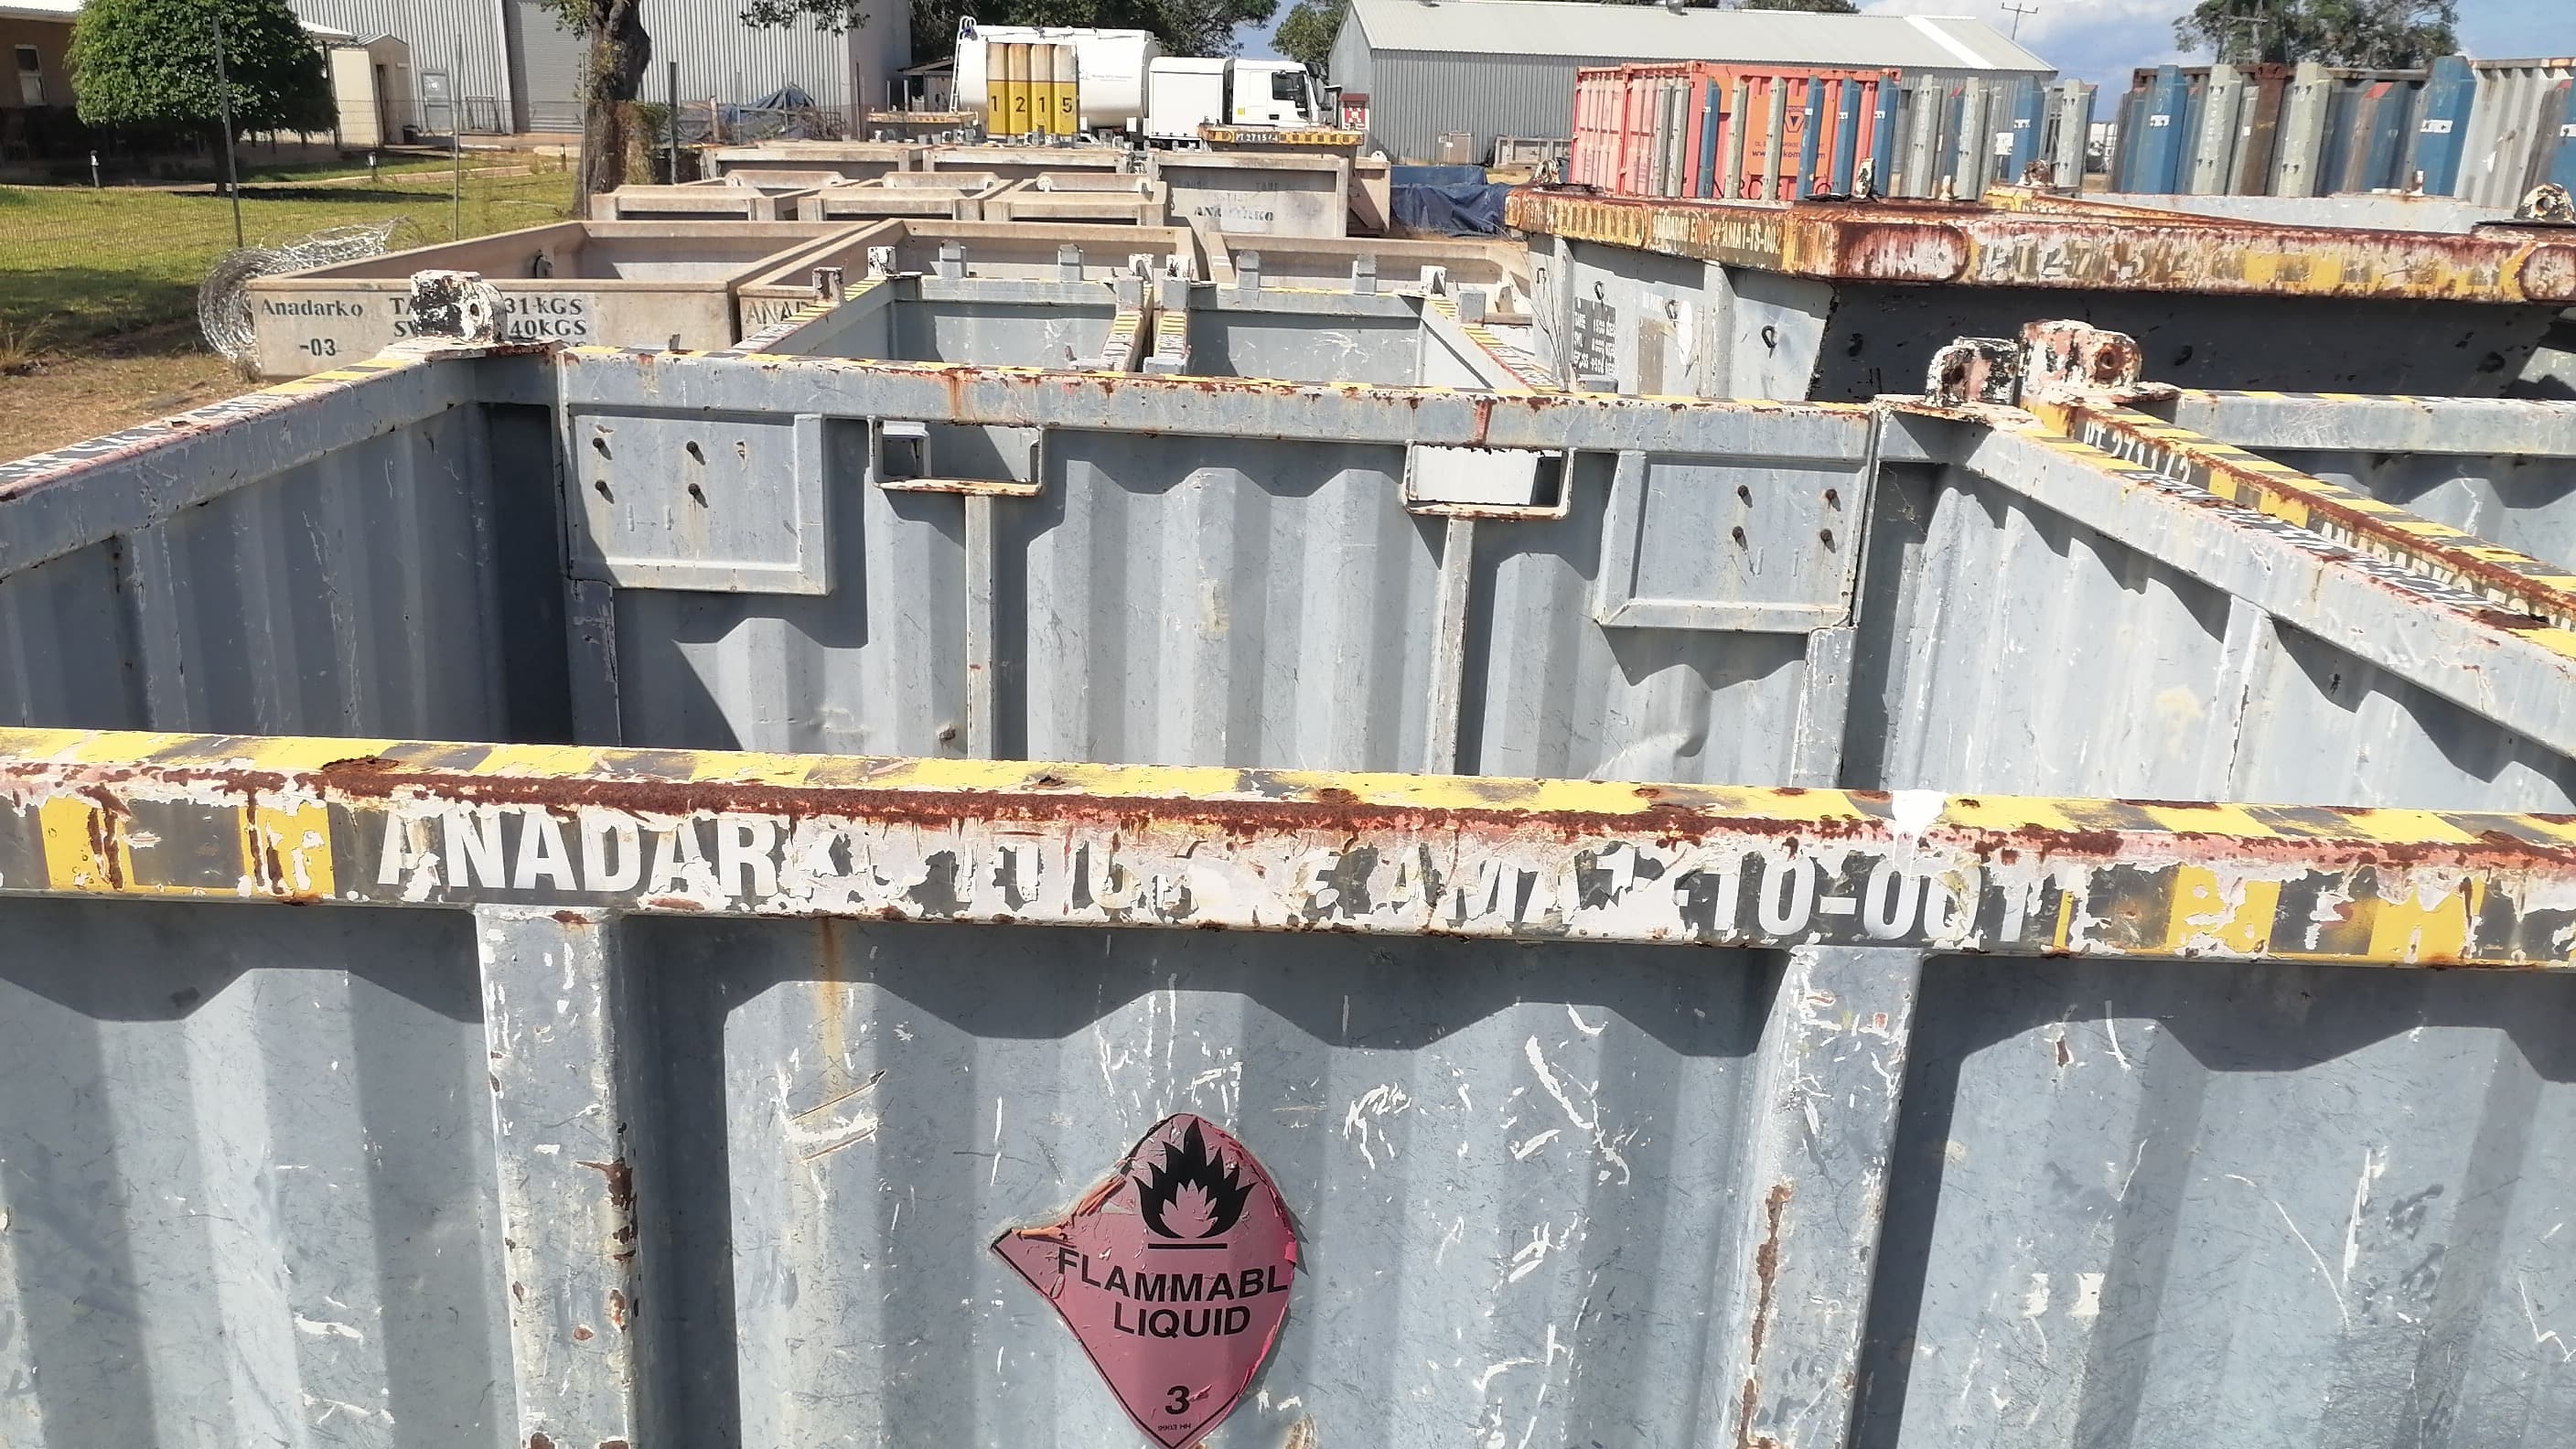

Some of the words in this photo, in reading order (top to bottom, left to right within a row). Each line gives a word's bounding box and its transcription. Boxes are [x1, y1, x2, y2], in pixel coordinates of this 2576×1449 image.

[261, 298, 364, 317] Anadarko
[299, 338, 337, 357] -03
[1057, 1246, 1289, 1303] FLAMMABL
[1113, 1301, 1251, 1339] LIQUID
[1165, 1385, 1191, 1416] 3
